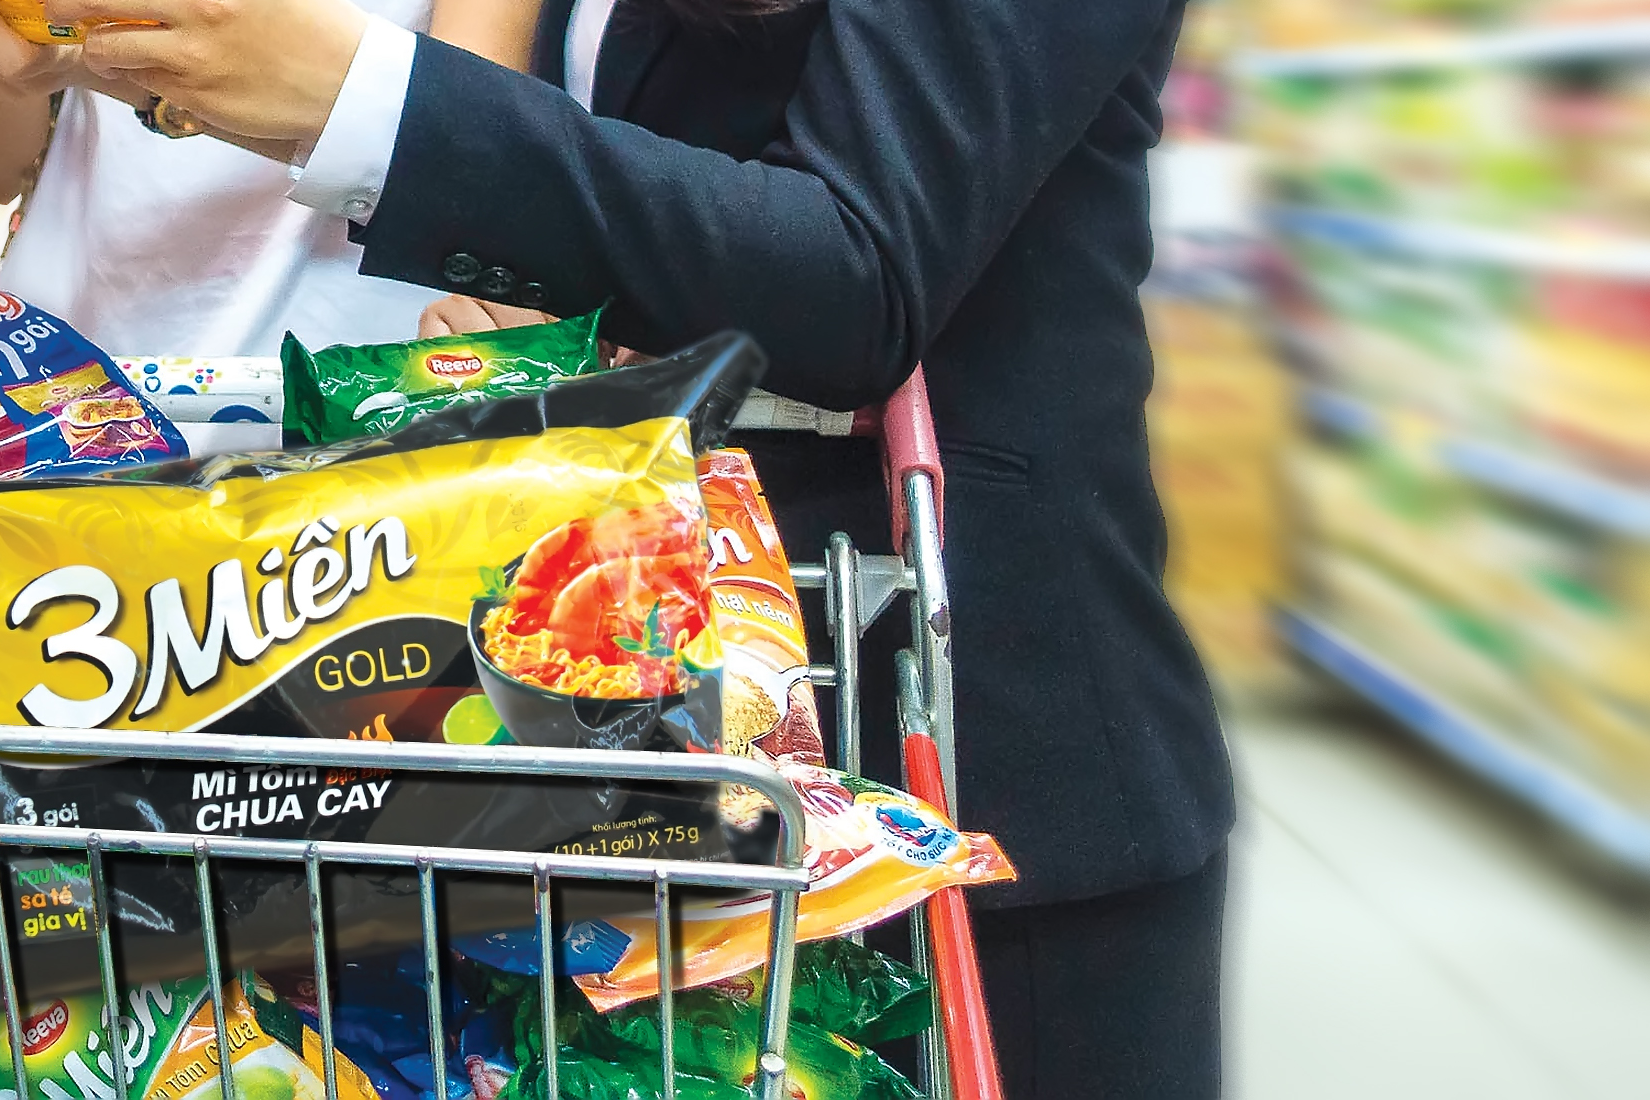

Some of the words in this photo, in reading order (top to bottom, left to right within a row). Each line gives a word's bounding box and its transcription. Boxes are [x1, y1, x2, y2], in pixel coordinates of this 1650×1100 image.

[9, 316, 60, 354] gói
[431, 357, 481, 374] Reeva
[6, 565, 138, 728] 3
[314, 643, 431, 692] GOLD
[192, 769, 237, 800] Mì
[243, 764, 318, 793] Tôm
[16, 797, 38, 826] 3
[43, 802, 80, 828] gói
[196, 794, 304, 832] CHUA
[317, 779, 393, 817] CAY
[17, 866, 51, 886] rau
[21, 893, 47, 910] sa
[23, 911, 61, 937] gia
[65, 907, 88, 931] vị
[205, 1020, 259, 1066] Cua
